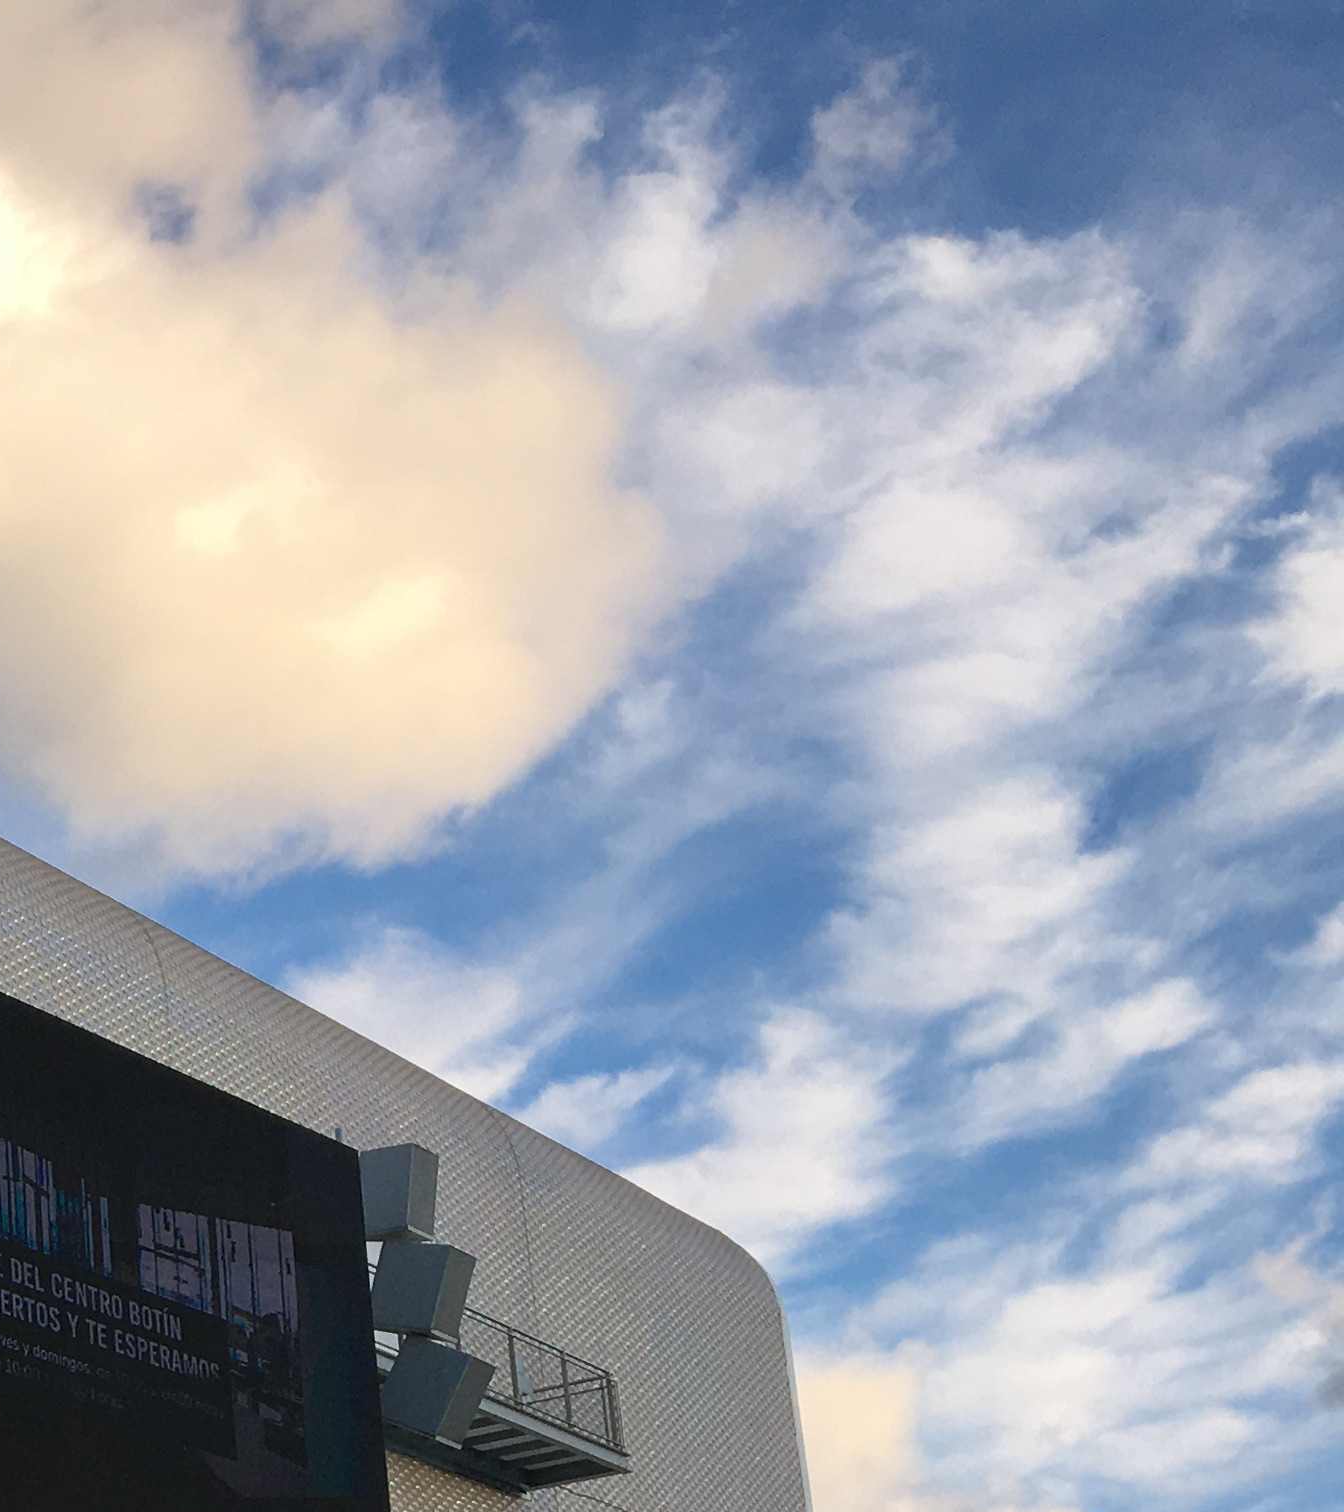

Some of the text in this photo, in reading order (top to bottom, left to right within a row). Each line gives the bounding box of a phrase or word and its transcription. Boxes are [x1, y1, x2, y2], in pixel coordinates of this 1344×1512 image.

[11, 1257, 44, 1292] DEL
[51, 1273, 123, 1319] CENTRO
[129, 1301, 183, 1341] BOTÍN
[67, 1311, 80, 1338] Y
[85, 1318, 108, 1349] TE
[114, 1329, 220, 1379] ESPERAMOS
